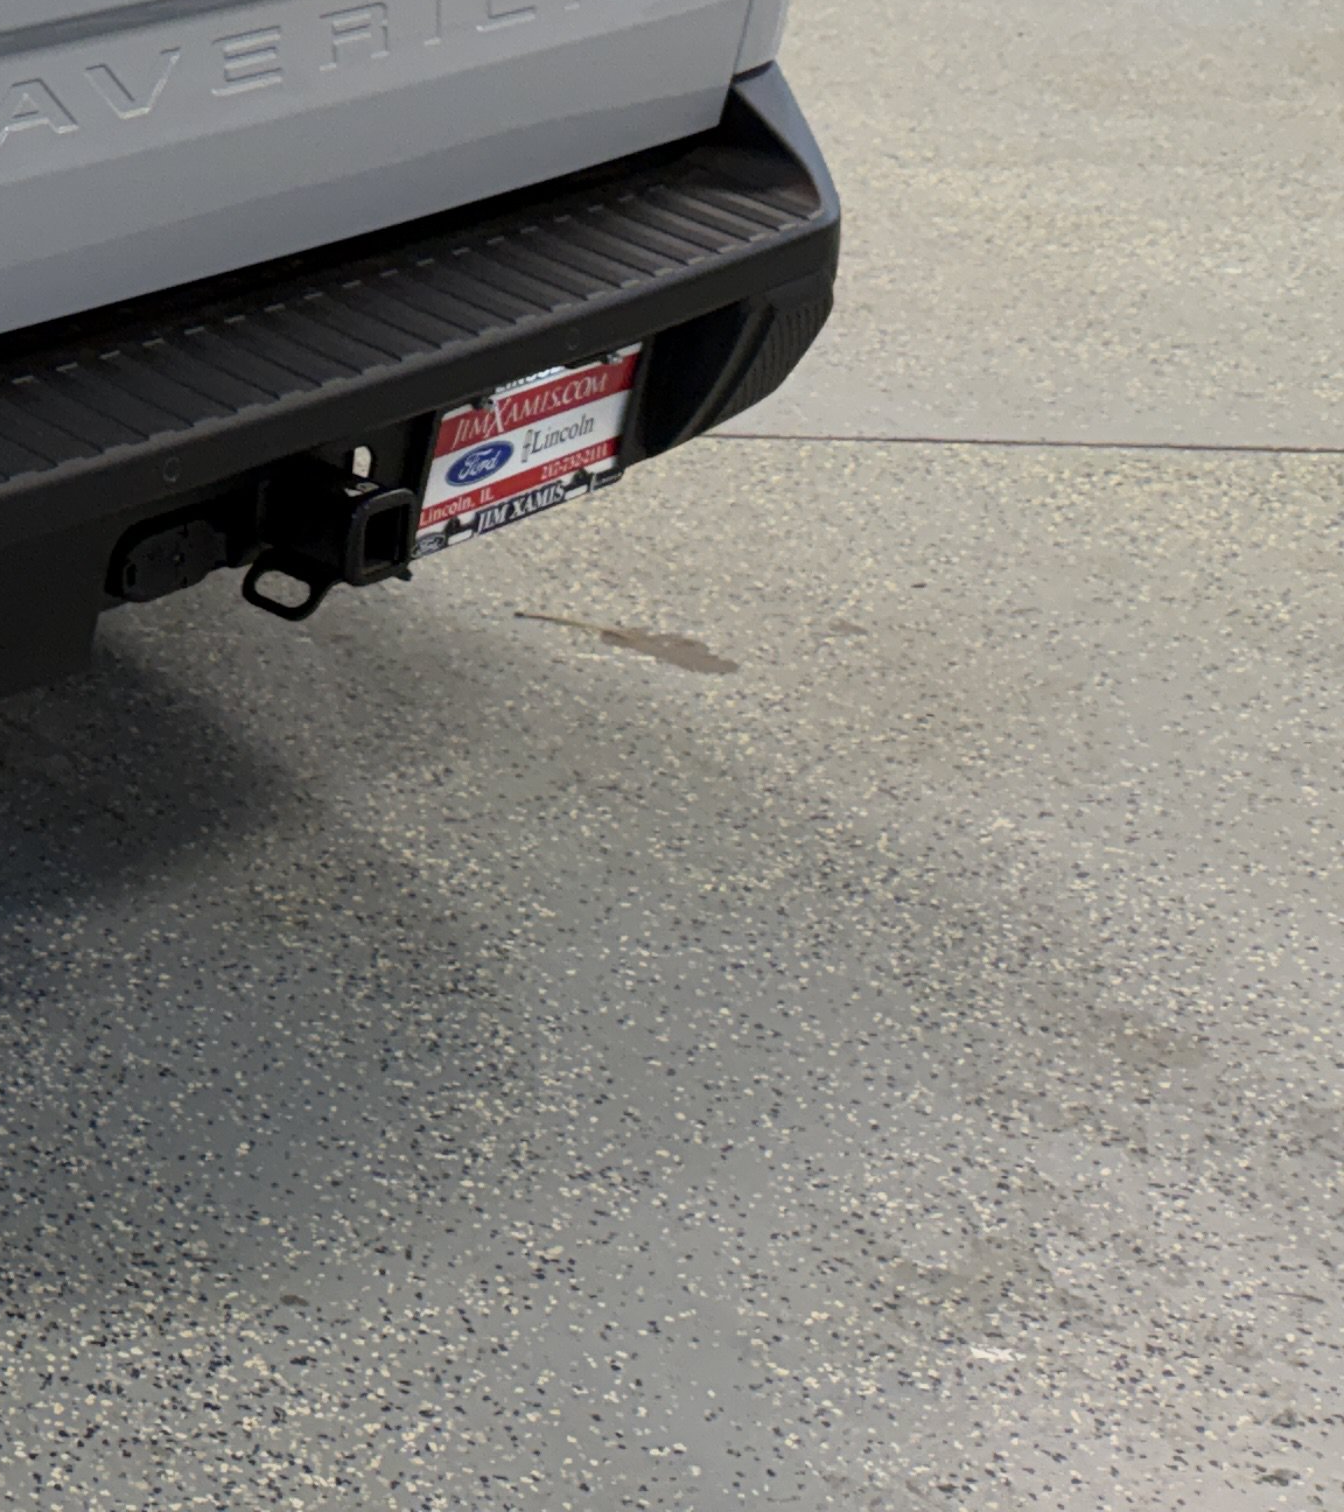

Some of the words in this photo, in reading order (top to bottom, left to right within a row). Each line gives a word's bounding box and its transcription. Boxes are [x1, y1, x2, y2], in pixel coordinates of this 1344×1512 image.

[532, 414, 594, 454] Lincoln
[459, 451, 499, 478] Ford
[478, 508, 509, 533] JIM
[512, 484, 565, 516] XAMIS
[481, 487, 494, 504] IL
